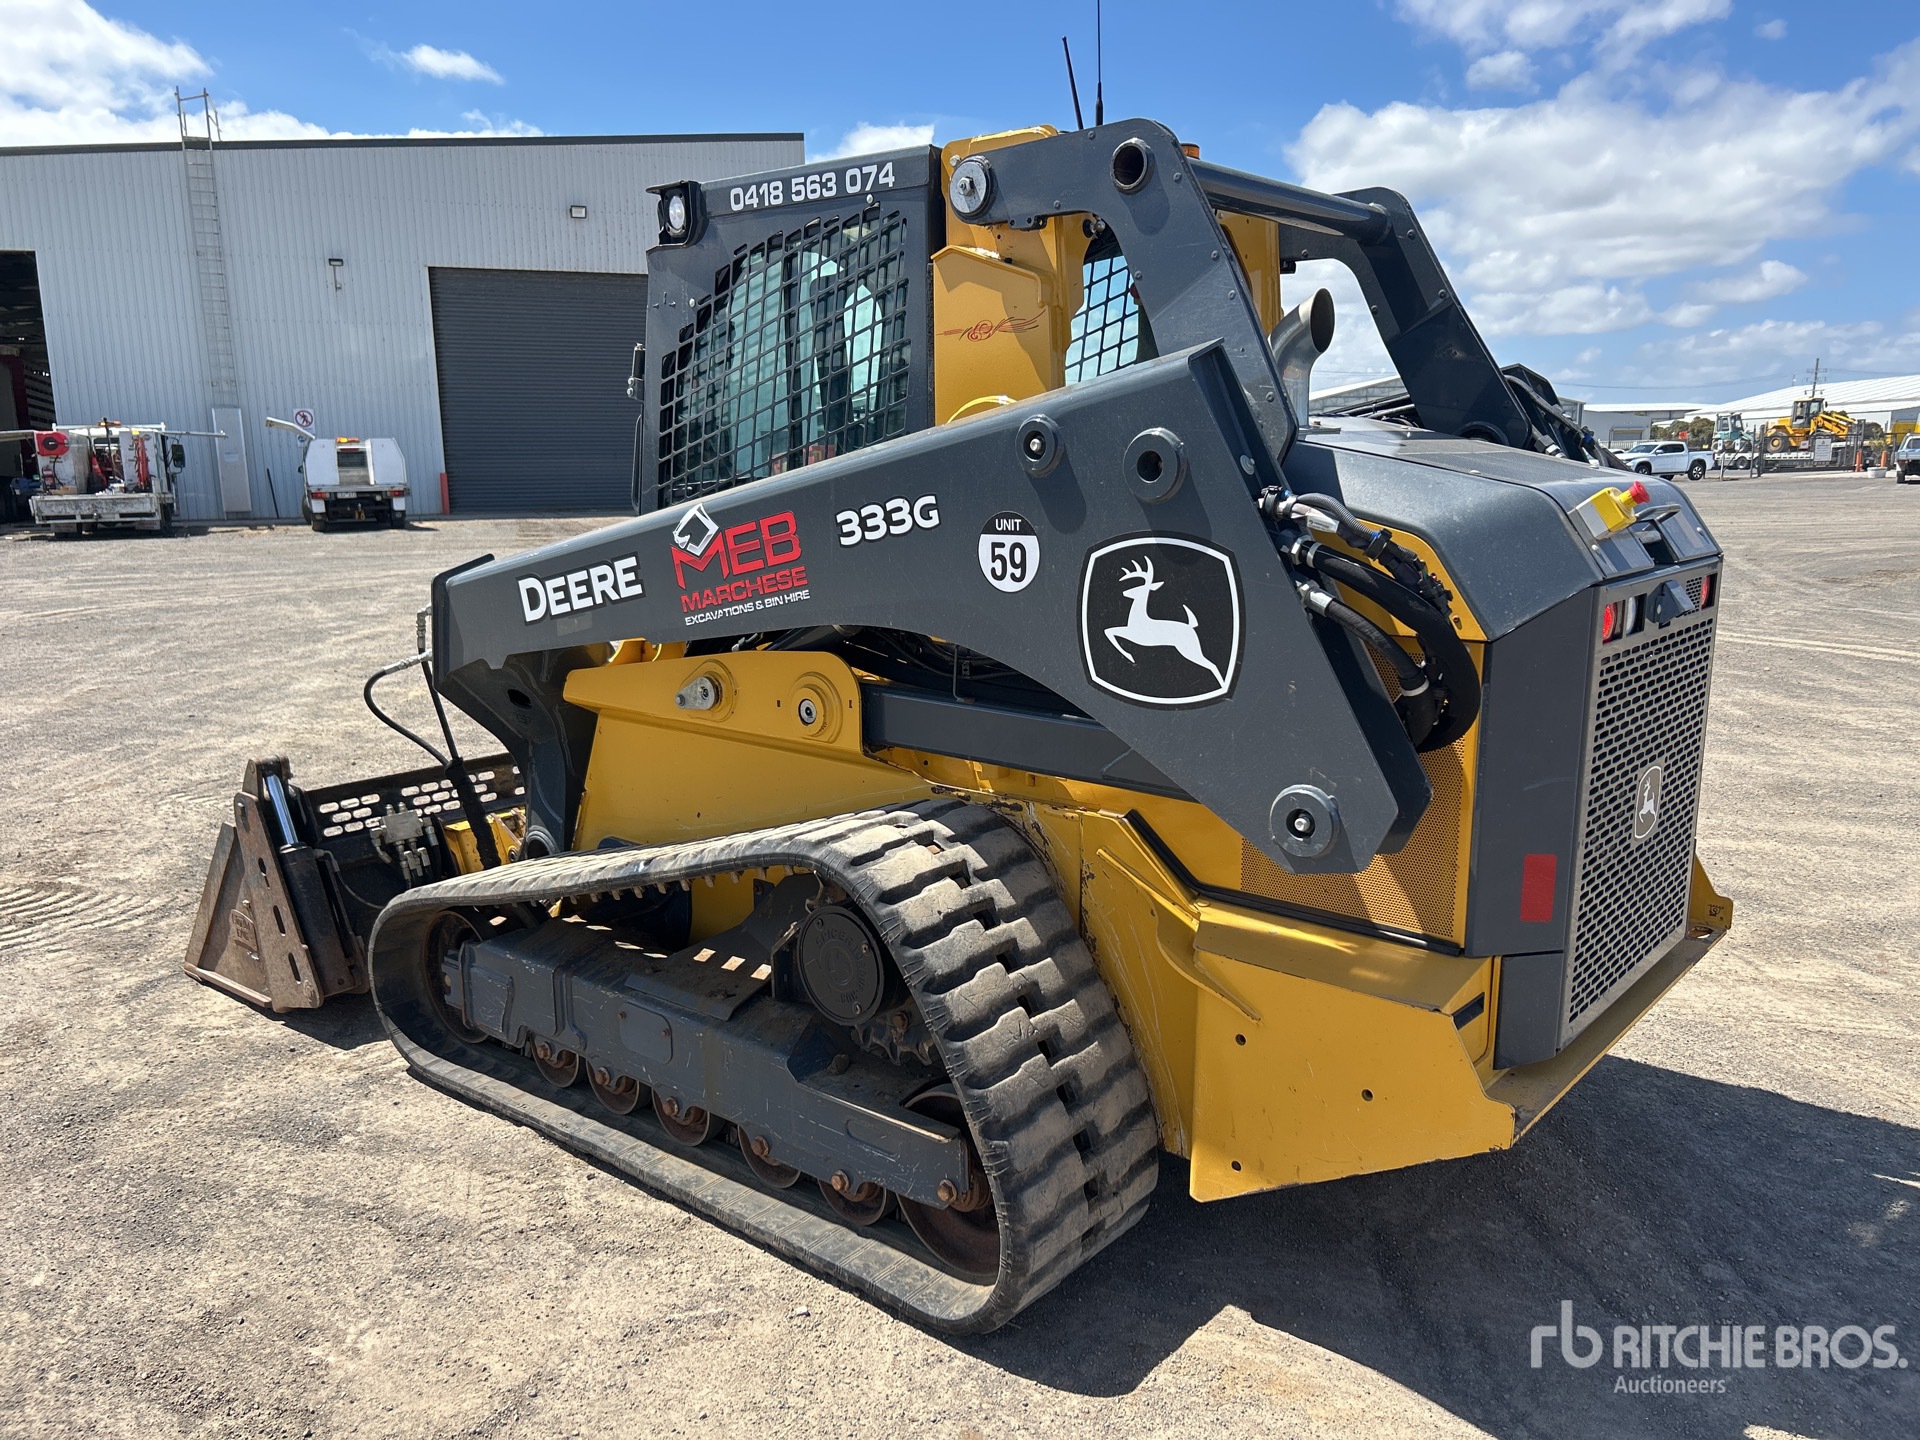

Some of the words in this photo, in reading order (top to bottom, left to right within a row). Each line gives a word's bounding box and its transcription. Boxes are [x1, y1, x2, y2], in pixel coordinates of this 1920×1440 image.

[729, 180, 784, 212] 0418
[791, 171, 837, 203] 563
[845, 161, 895, 194] 074
[835, 494, 940, 546] 333G
[994, 518, 1022, 532] UNIT
[670, 510, 803, 590] MEB
[990, 541, 1028, 583] 59
[518, 555, 643, 623] DEERE
[680, 565, 808, 614] MARCHESE
[684, 602, 754, 626] EXCAVATIONS
[755, 600, 765, 610] &
[765, 596, 784, 608] BIN
[784, 590, 811, 605] HIRE
